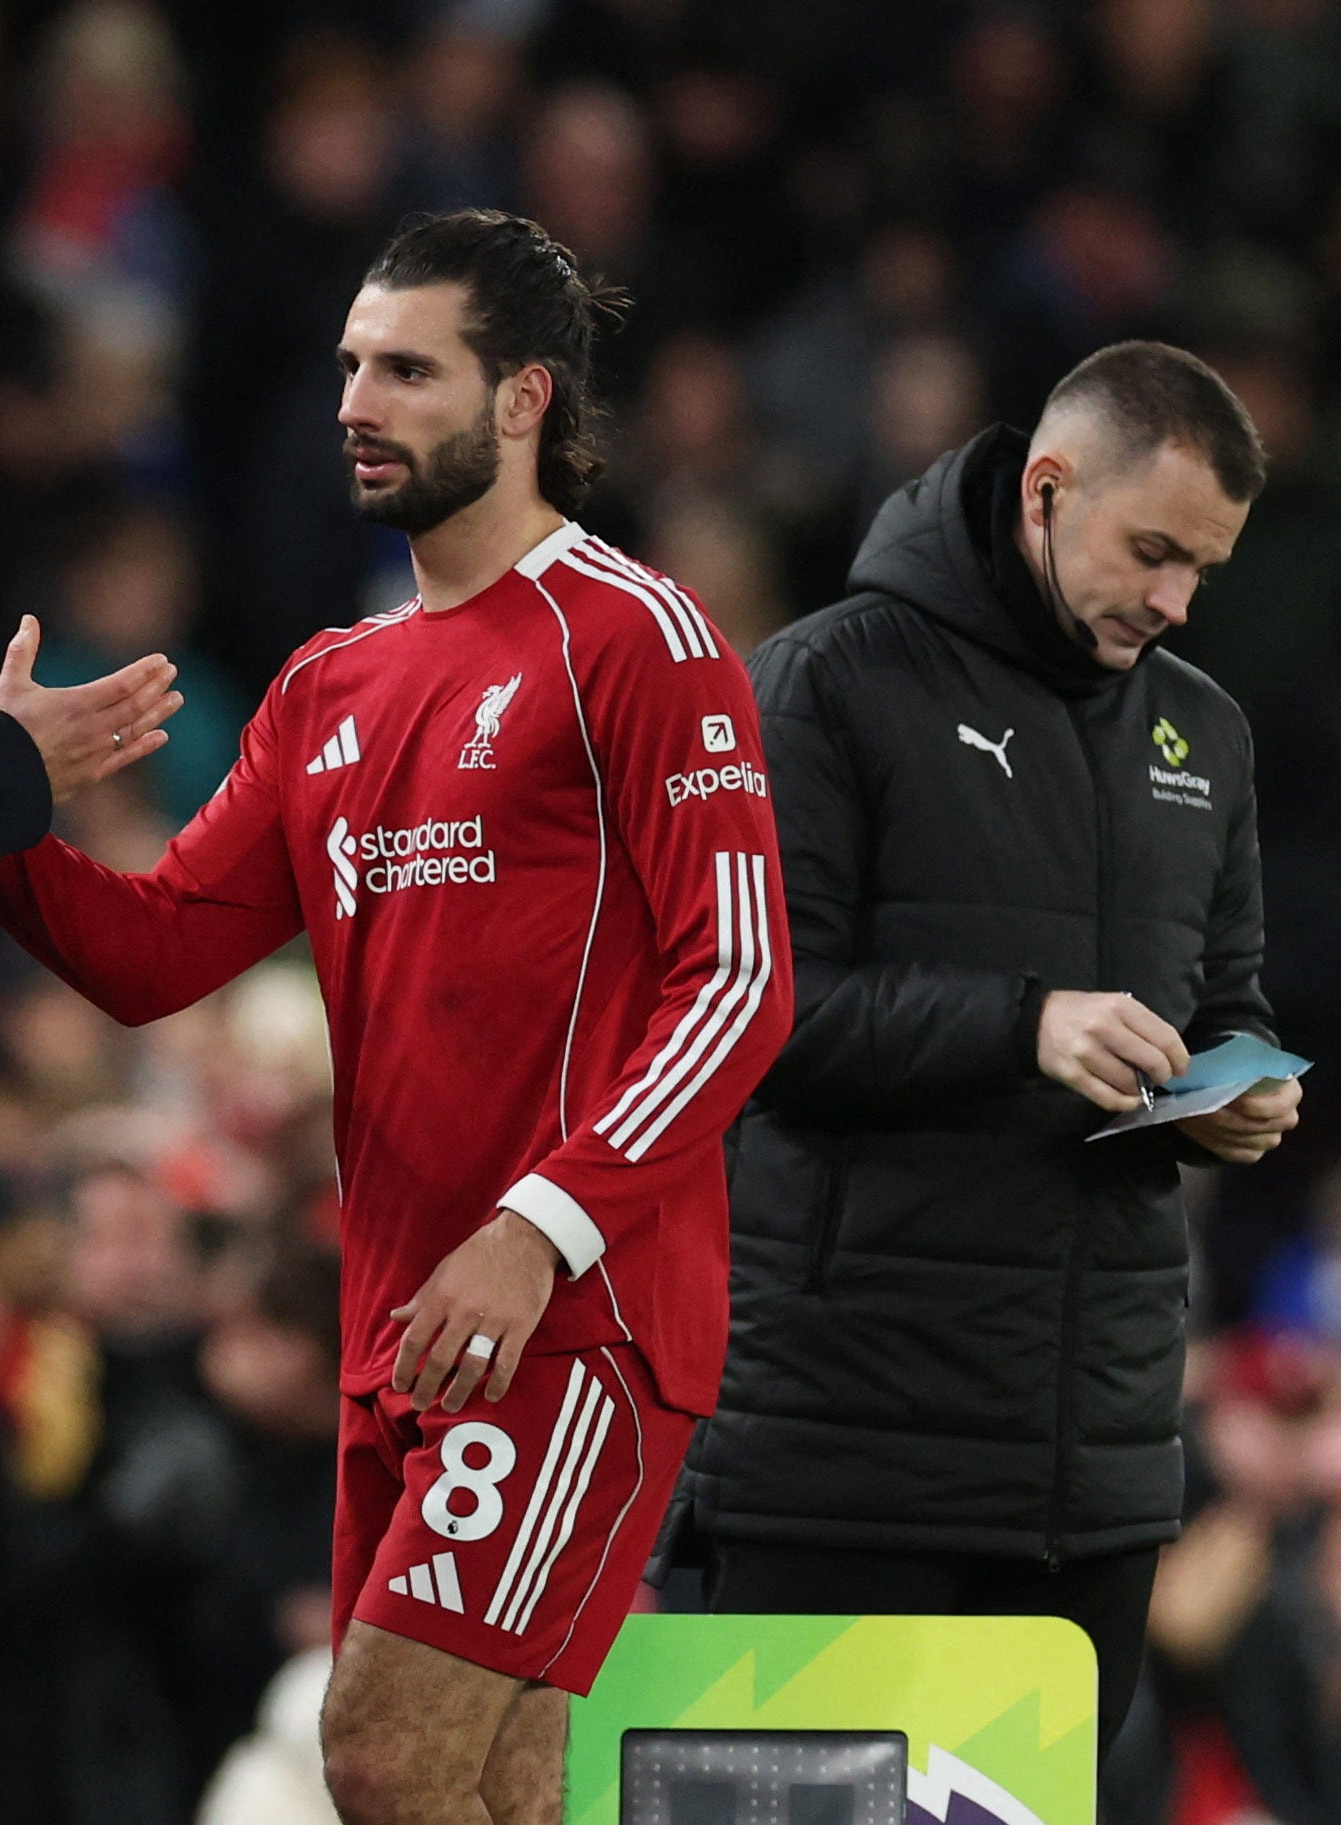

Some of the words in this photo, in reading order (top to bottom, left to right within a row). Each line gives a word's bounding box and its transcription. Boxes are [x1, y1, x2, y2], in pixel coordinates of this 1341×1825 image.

[360, 814, 483, 861] standard
[365, 849, 496, 894] chartered
[421, 1421, 517, 1542] 8
